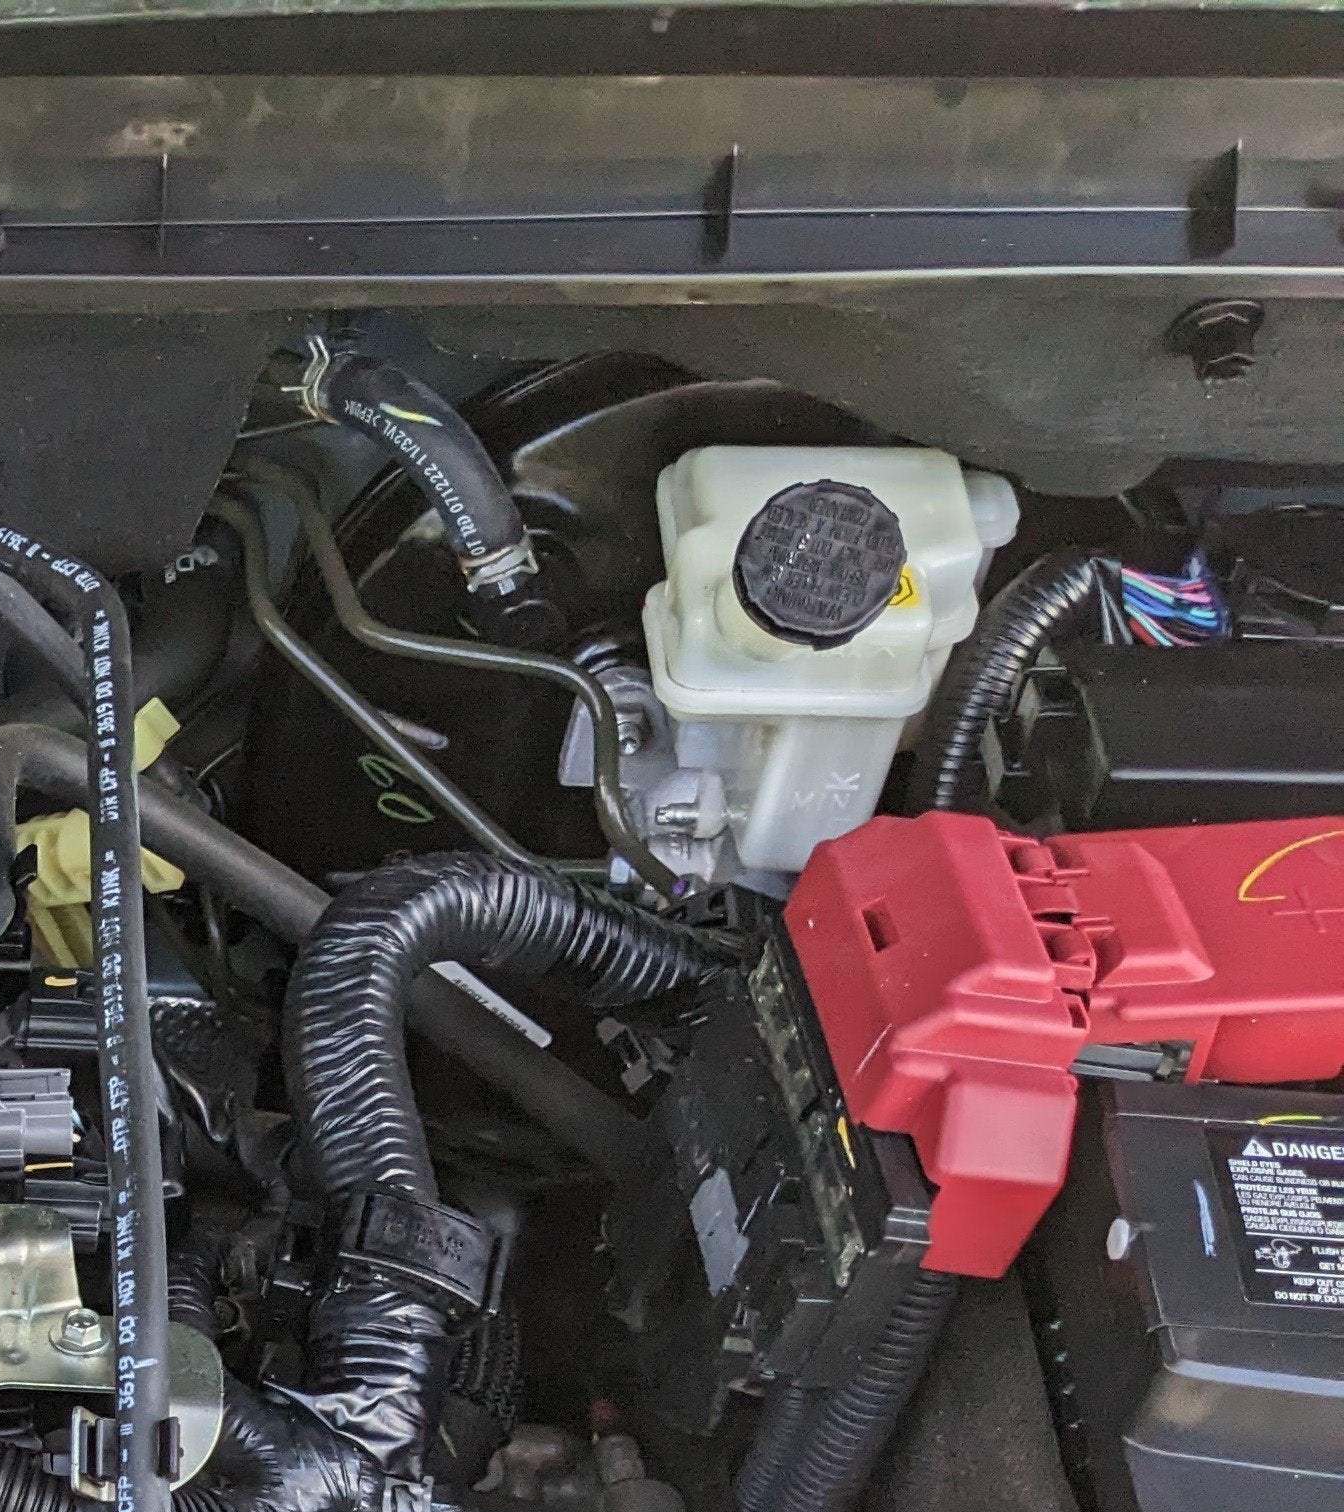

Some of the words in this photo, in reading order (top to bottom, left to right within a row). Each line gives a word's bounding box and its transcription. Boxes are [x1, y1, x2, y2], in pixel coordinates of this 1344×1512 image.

[423, 462, 464, 515] 071222
[1271, 1141, 1344, 1161] DANGE
[115, 1211, 135, 1262] KINK
[117, 1269, 136, 1308] NOT
[118, 1317, 138, 1346] DO
[118, 1355, 136, 1411] 3619
